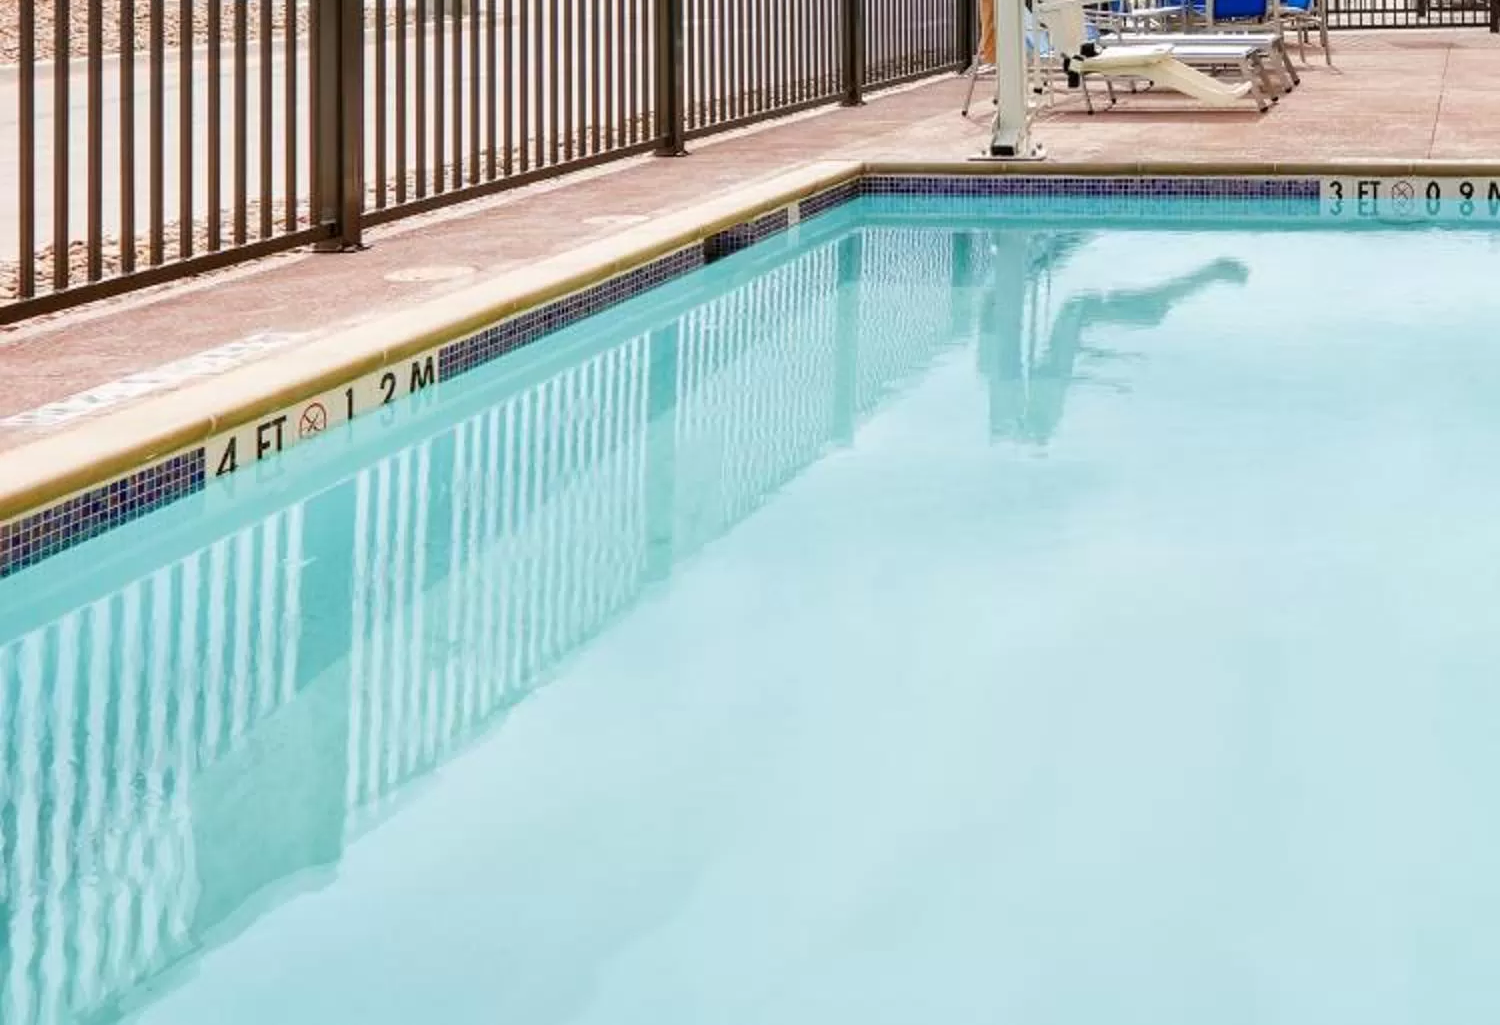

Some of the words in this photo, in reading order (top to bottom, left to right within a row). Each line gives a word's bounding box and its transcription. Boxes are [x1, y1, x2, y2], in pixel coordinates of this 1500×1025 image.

[1329, 181, 1343, 201] 3
[1358, 181, 1381, 200] FT
[215, 436, 238, 477] 4
[257, 415, 287, 460] FT
